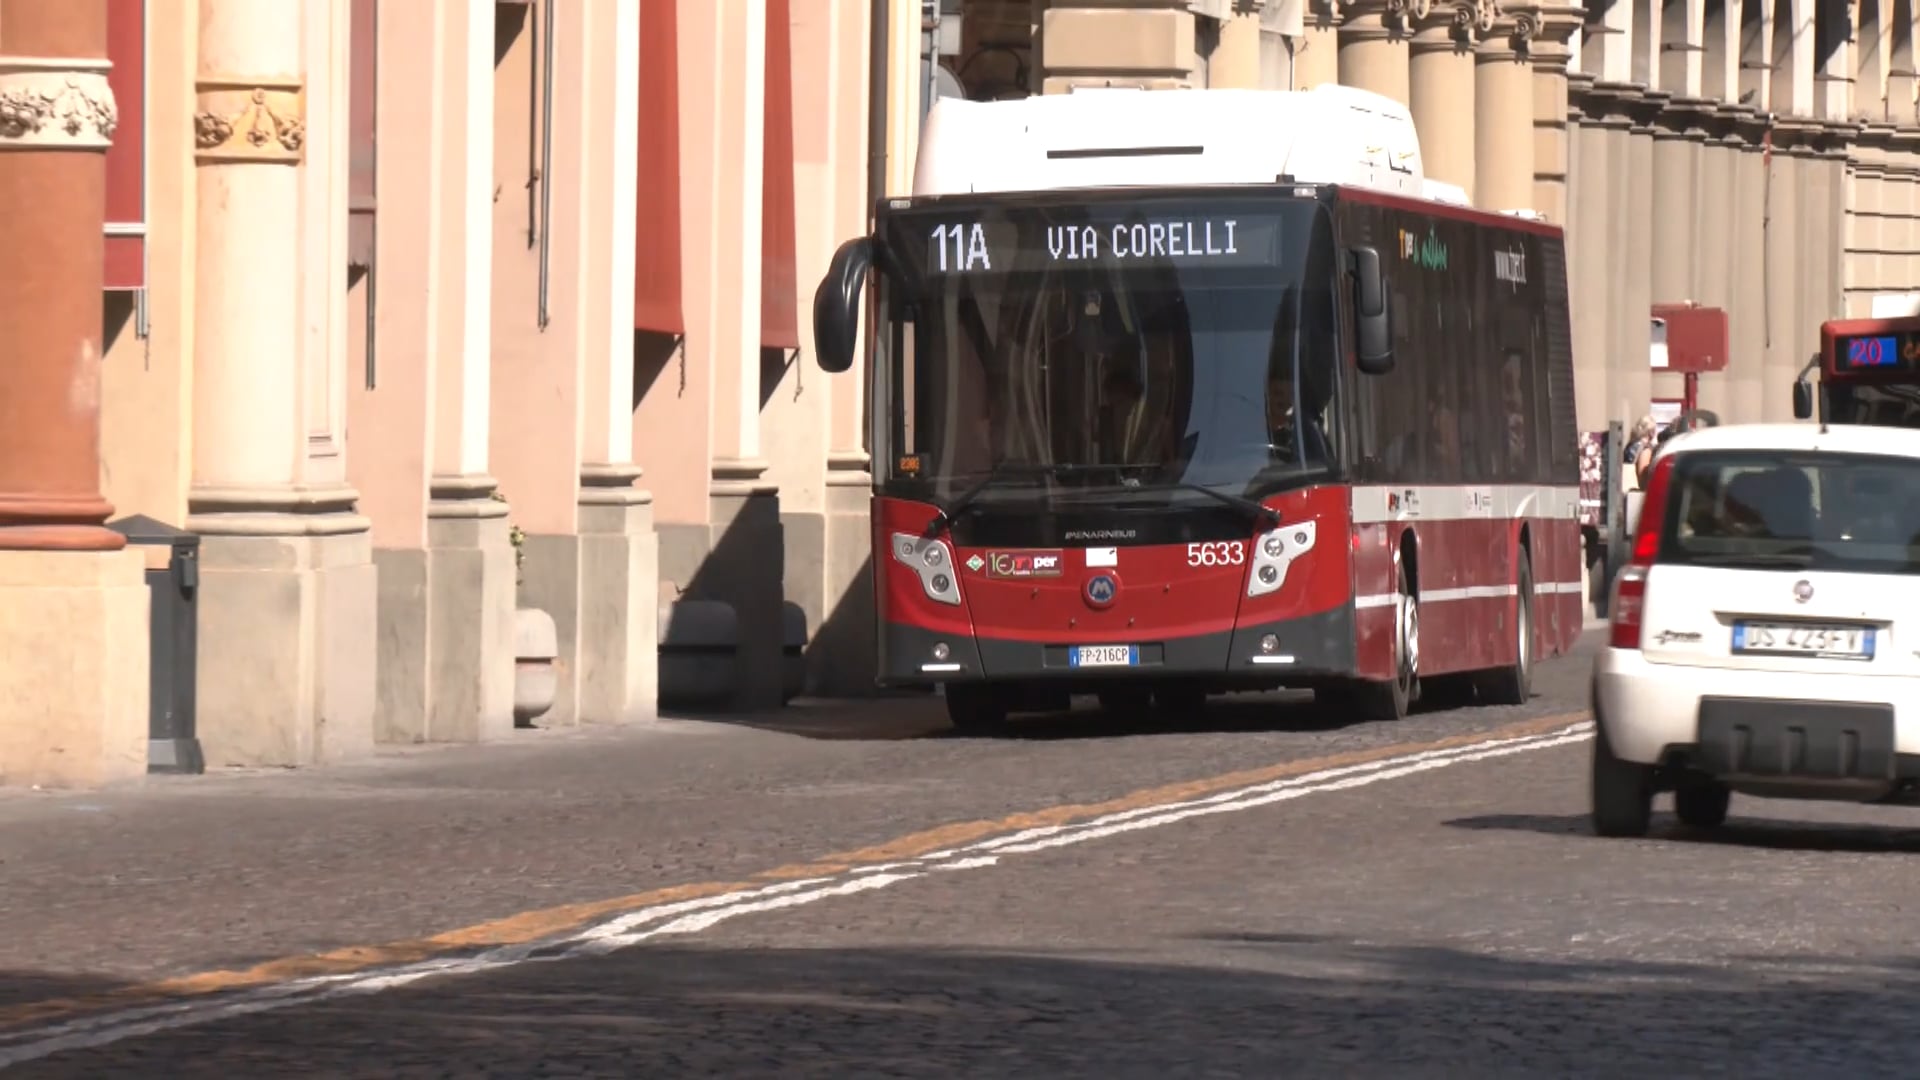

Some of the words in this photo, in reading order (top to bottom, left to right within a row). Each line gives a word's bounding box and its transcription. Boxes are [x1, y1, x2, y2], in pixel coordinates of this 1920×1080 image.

[930, 222, 991, 272] 11A
[1047, 225, 1098, 260] VIA
[1112, 219, 1238, 259] CORELLI
[1850, 337, 1882, 367] 20
[1187, 541, 1245, 566] 5633
